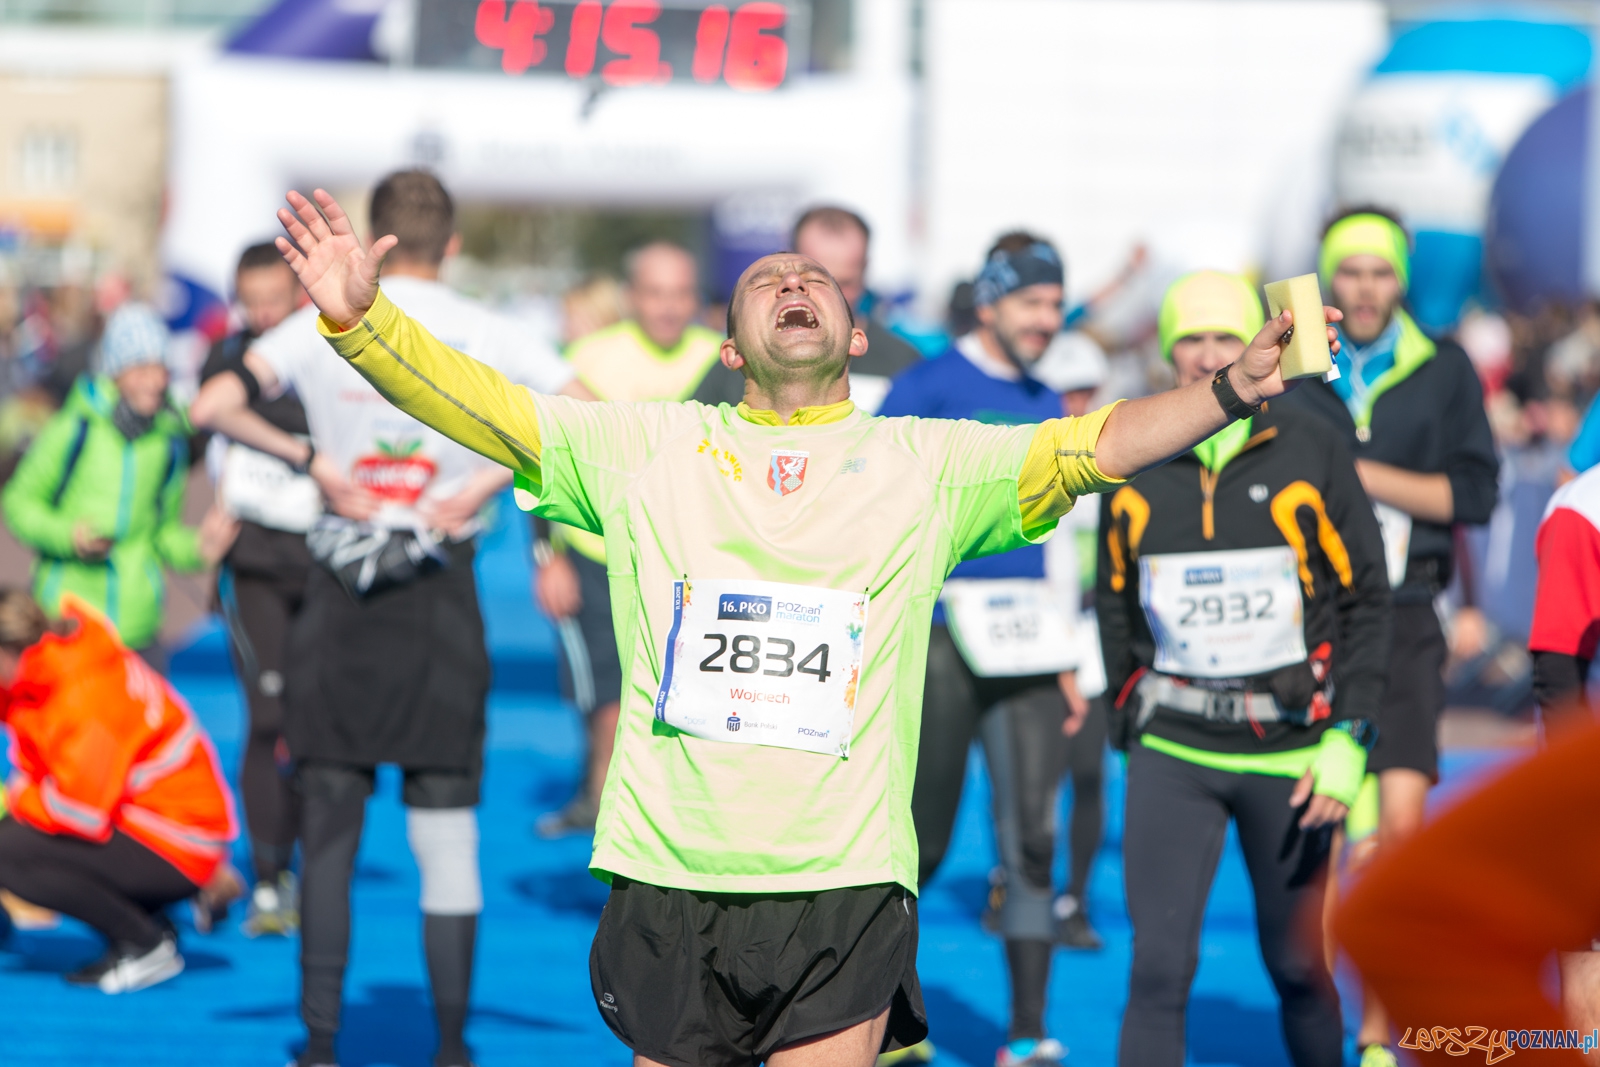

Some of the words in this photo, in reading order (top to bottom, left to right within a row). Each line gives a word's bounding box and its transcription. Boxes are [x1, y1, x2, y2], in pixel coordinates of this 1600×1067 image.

[721, 601, 738, 613] 16.
[738, 602, 767, 615] PKO
[1177, 588, 1276, 628] 2932
[775, 610, 820, 623] maraton
[698, 633, 832, 683] 2834
[730, 688, 791, 705] Wojciech
[760, 722, 778, 730] Polski
